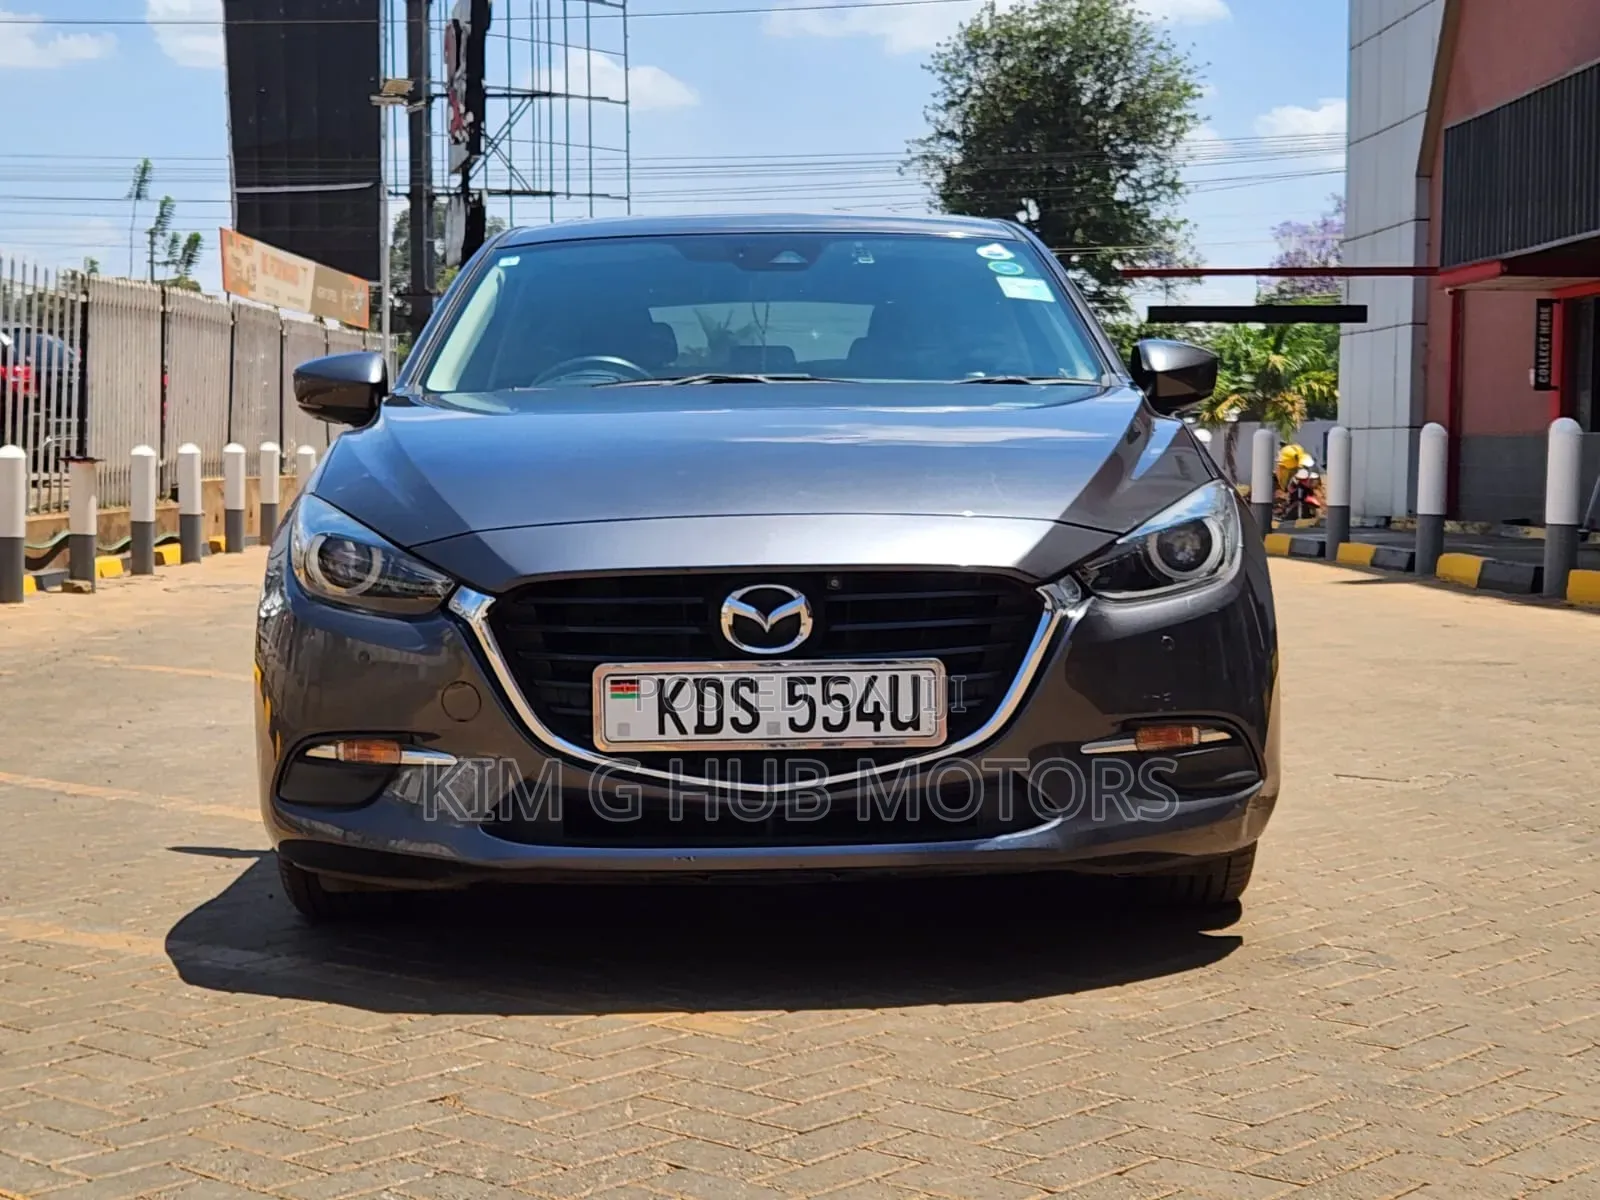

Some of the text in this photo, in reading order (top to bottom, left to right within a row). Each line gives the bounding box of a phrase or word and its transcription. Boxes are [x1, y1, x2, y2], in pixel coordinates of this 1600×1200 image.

[1538, 306, 1551, 383] COLLECT HERE
[656, 677, 761, 735] KDS
[786, 674, 921, 733] 554U
